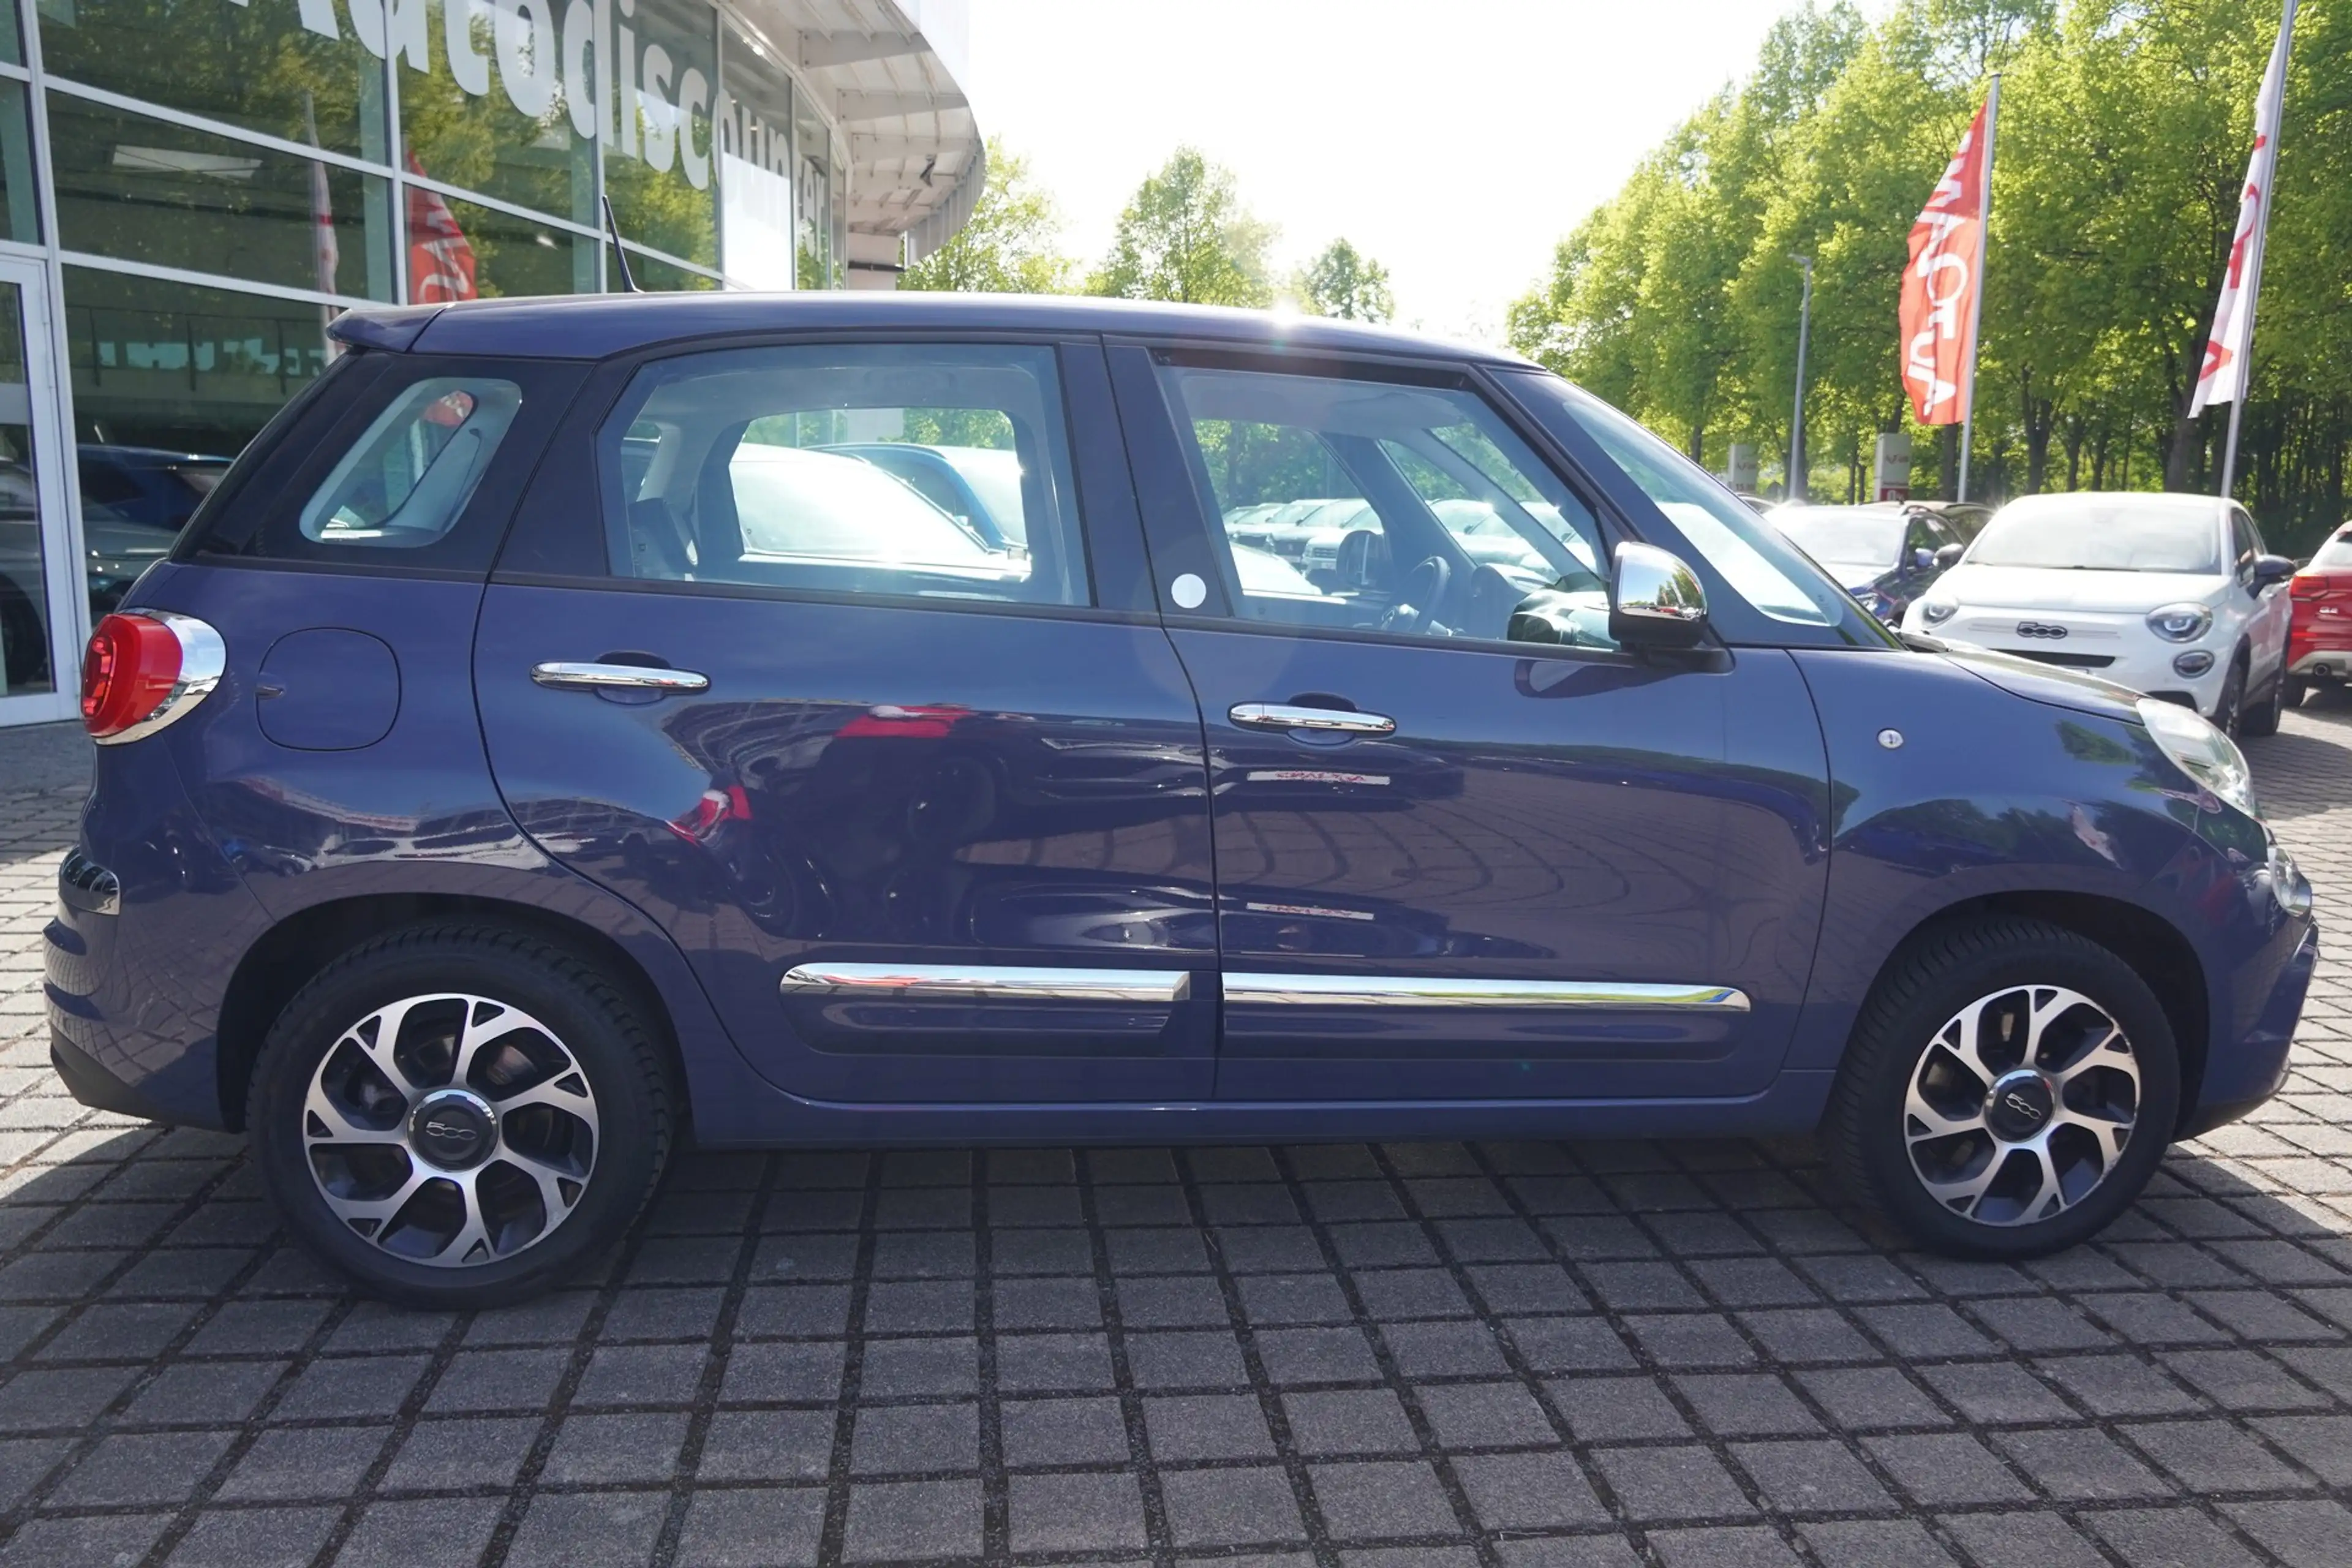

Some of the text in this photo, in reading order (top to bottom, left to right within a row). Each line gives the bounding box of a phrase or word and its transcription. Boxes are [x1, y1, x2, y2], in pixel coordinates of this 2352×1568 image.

[2016, 621, 2068, 639] 500
[2005, 1093, 2041, 1119] 500
[426, 1121, 477, 1140] 500
